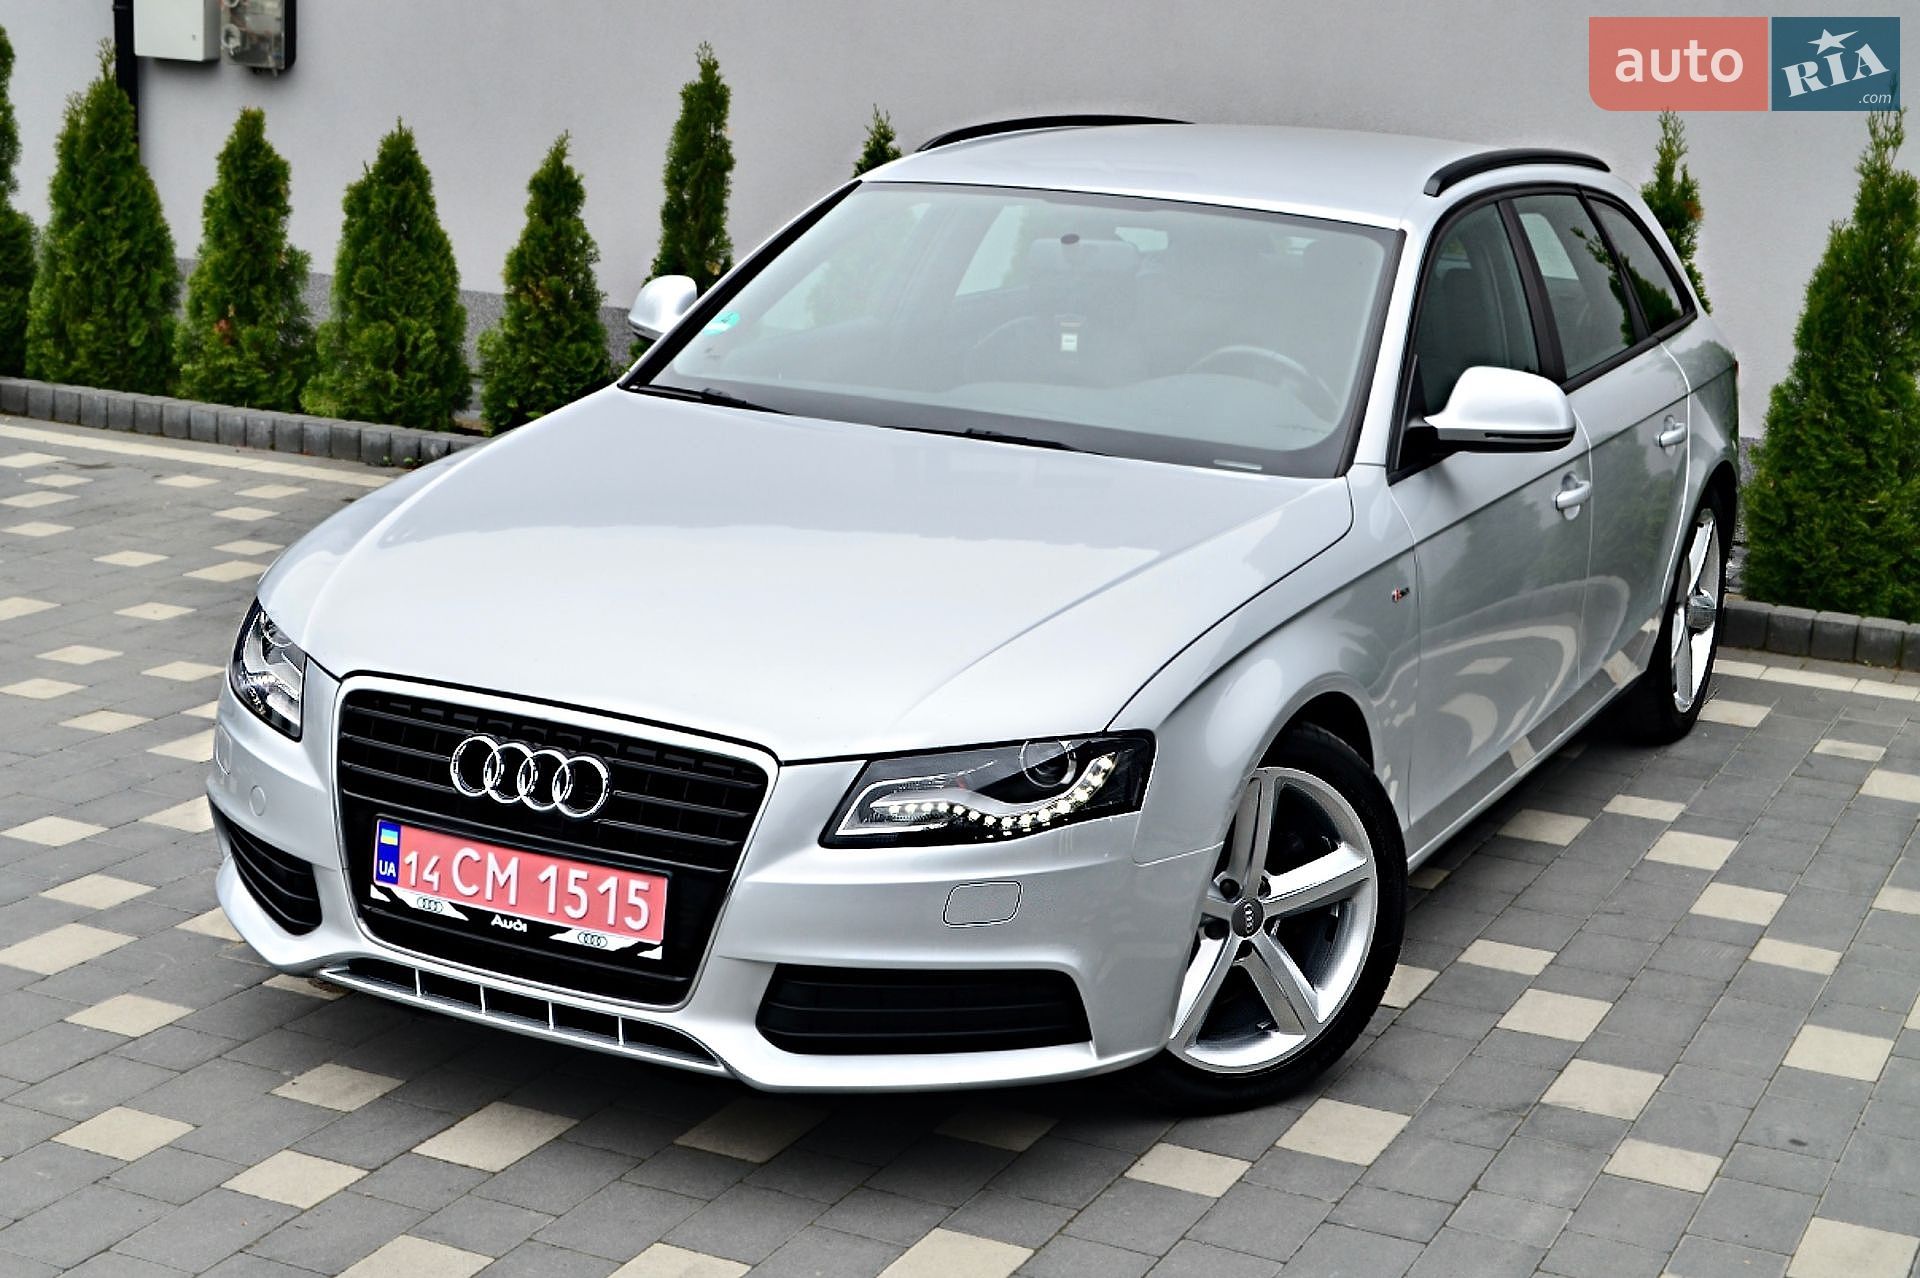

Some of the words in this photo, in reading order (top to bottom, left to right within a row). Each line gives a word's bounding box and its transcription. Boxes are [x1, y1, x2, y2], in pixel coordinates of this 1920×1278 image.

[379, 860, 396, 877] UA
[404, 850, 440, 892] 14
[452, 848, 520, 906] CM
[538, 864, 651, 931] 1515
[490, 914, 528, 932] Audi
